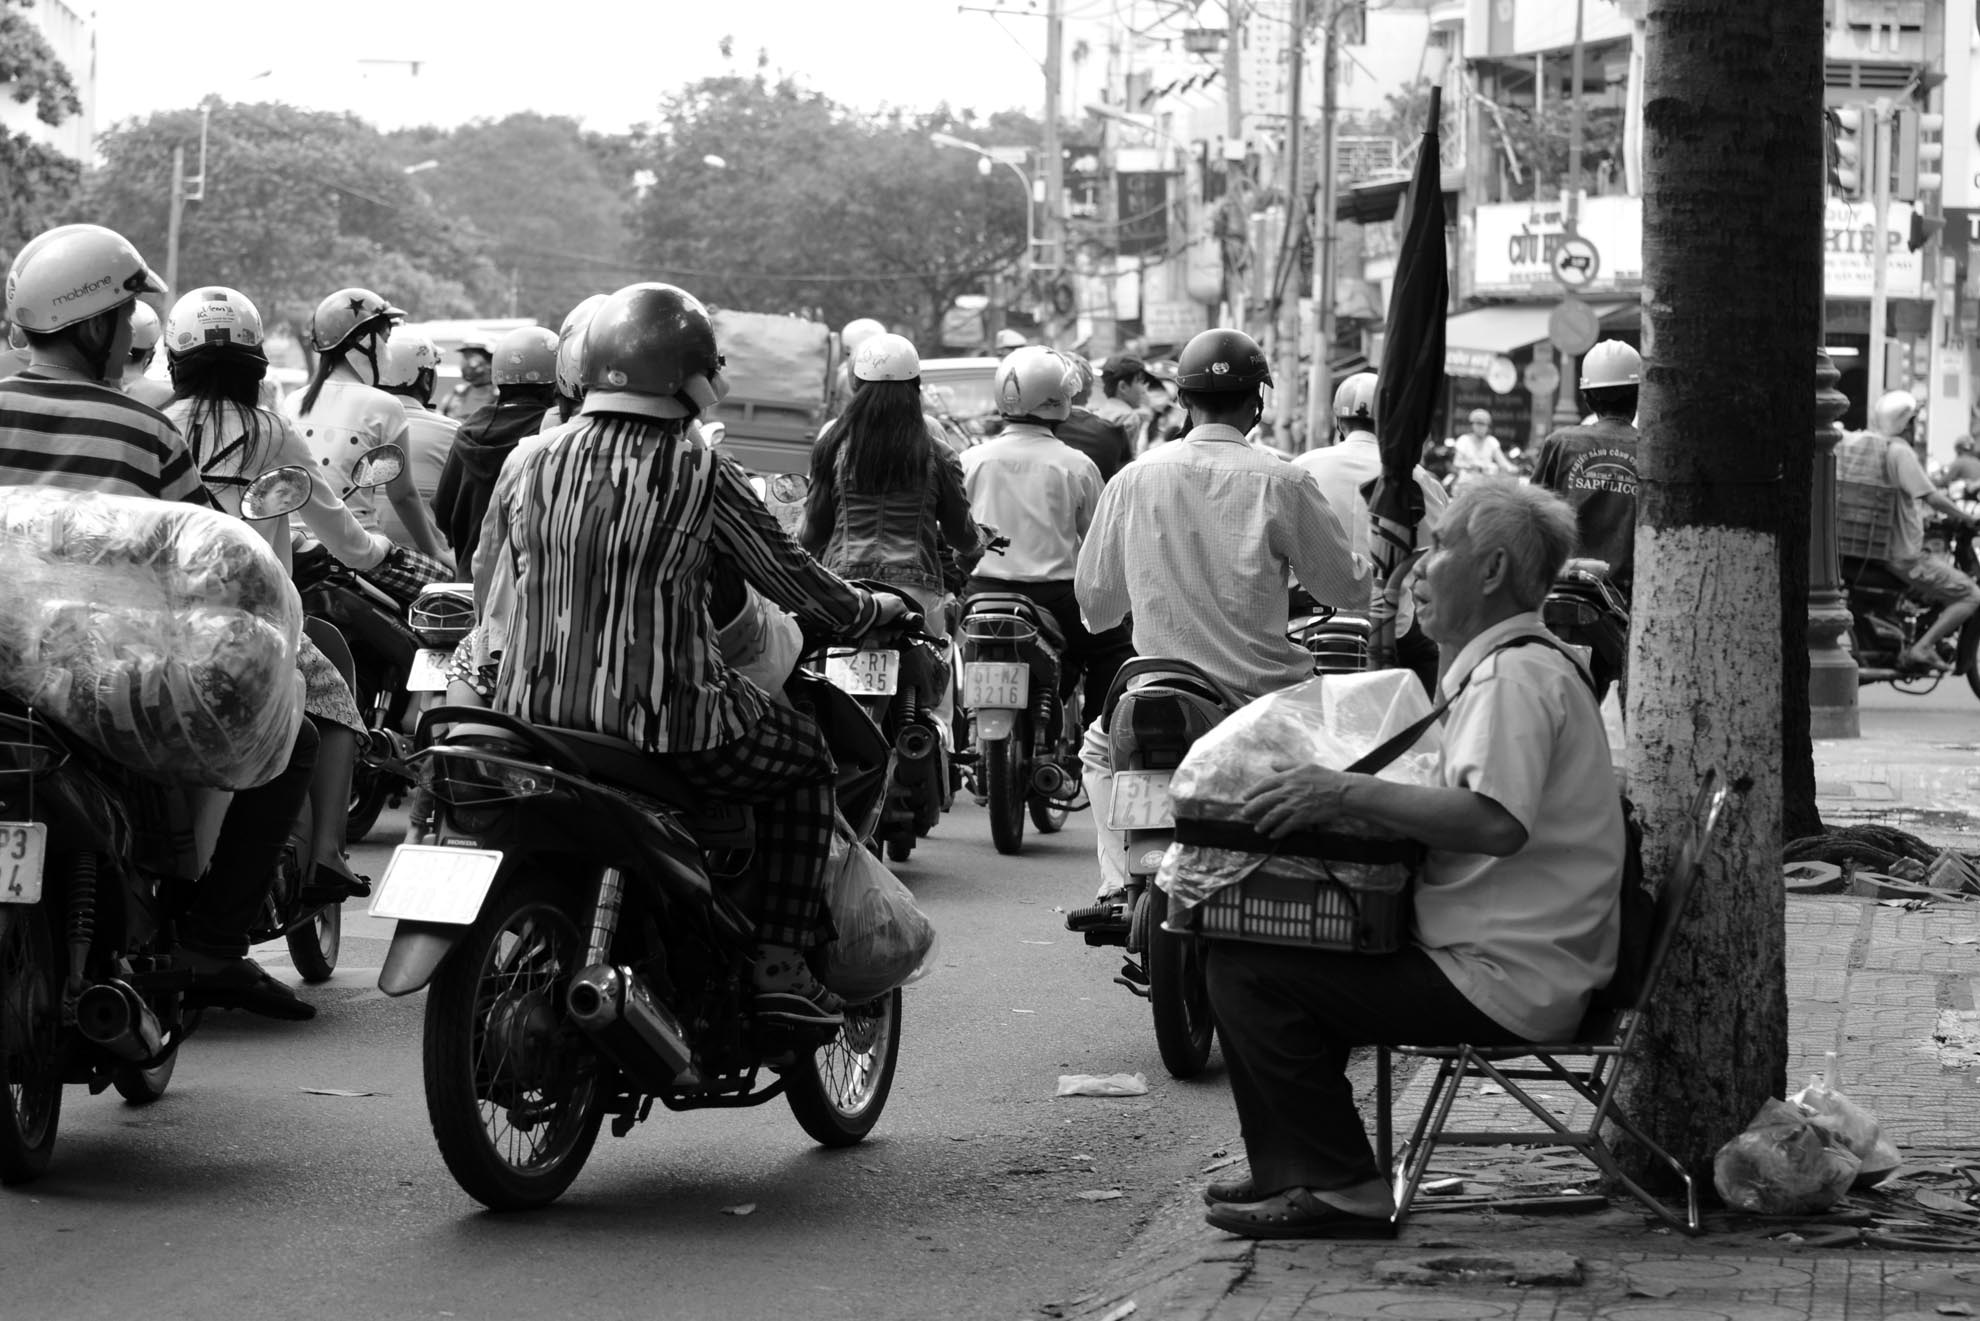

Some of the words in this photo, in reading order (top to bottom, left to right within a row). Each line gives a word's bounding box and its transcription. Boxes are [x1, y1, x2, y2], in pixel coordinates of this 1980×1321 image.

[52, 275, 112, 306] mobifone
[974, 686, 1018, 705] 3216
[446, 838, 479, 848] HONDA
